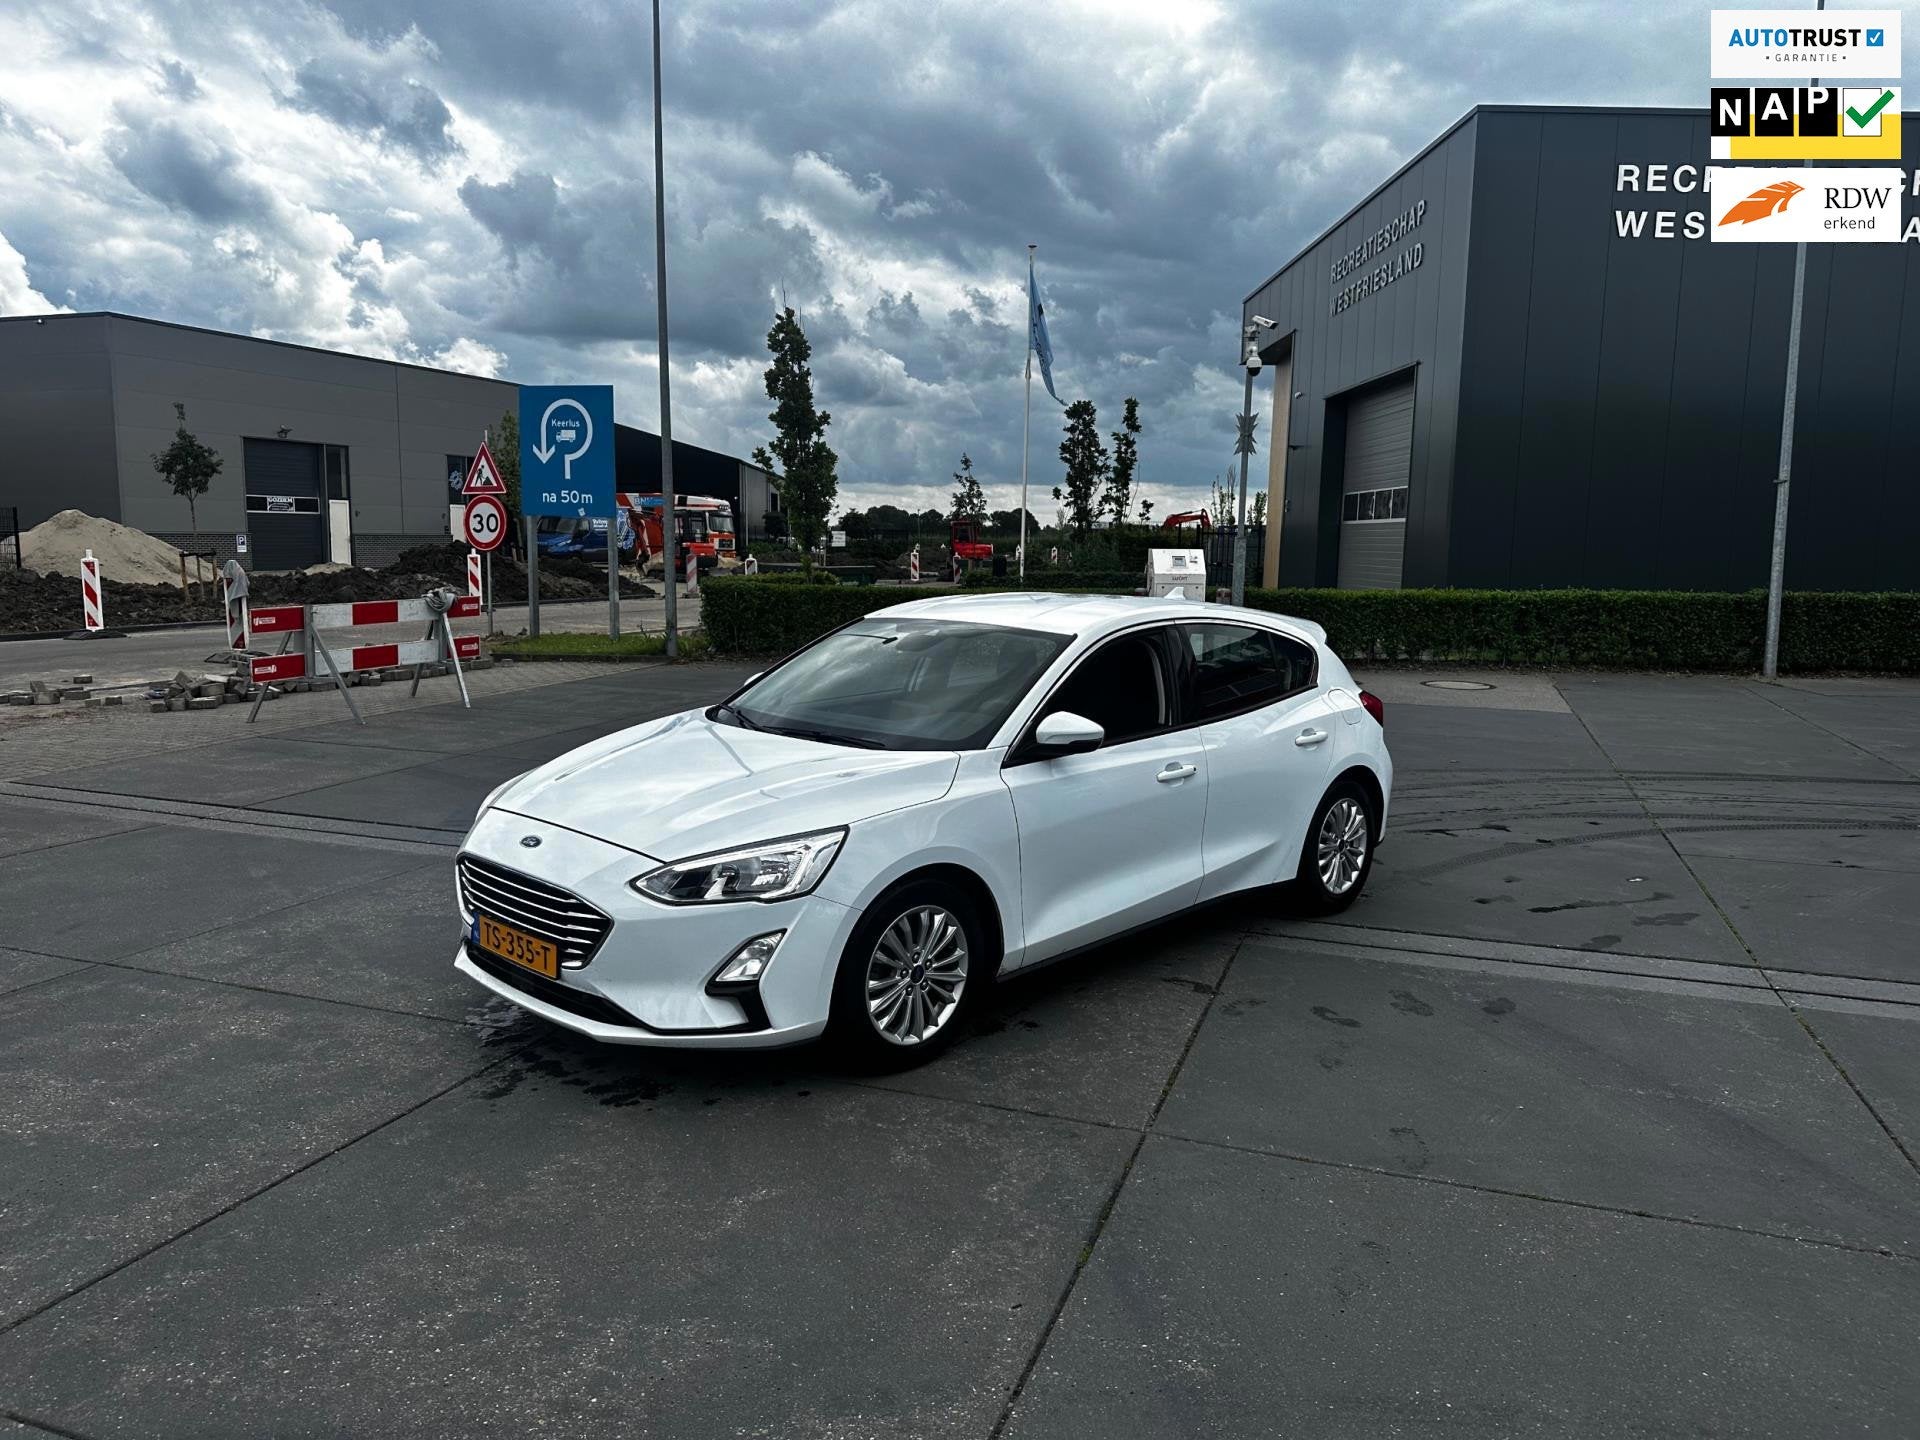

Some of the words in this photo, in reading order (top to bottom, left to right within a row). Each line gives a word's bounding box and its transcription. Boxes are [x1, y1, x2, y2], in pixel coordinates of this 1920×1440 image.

[1330, 200, 1425, 285] RECREATIESCHAP
[1329, 243, 1423, 318] WESTFRIESLAND
[551, 418, 581, 428] Keerlus
[542, 492, 556, 503] na
[472, 513, 499, 533] 30
[483, 921, 551, 971] TS-355-T
